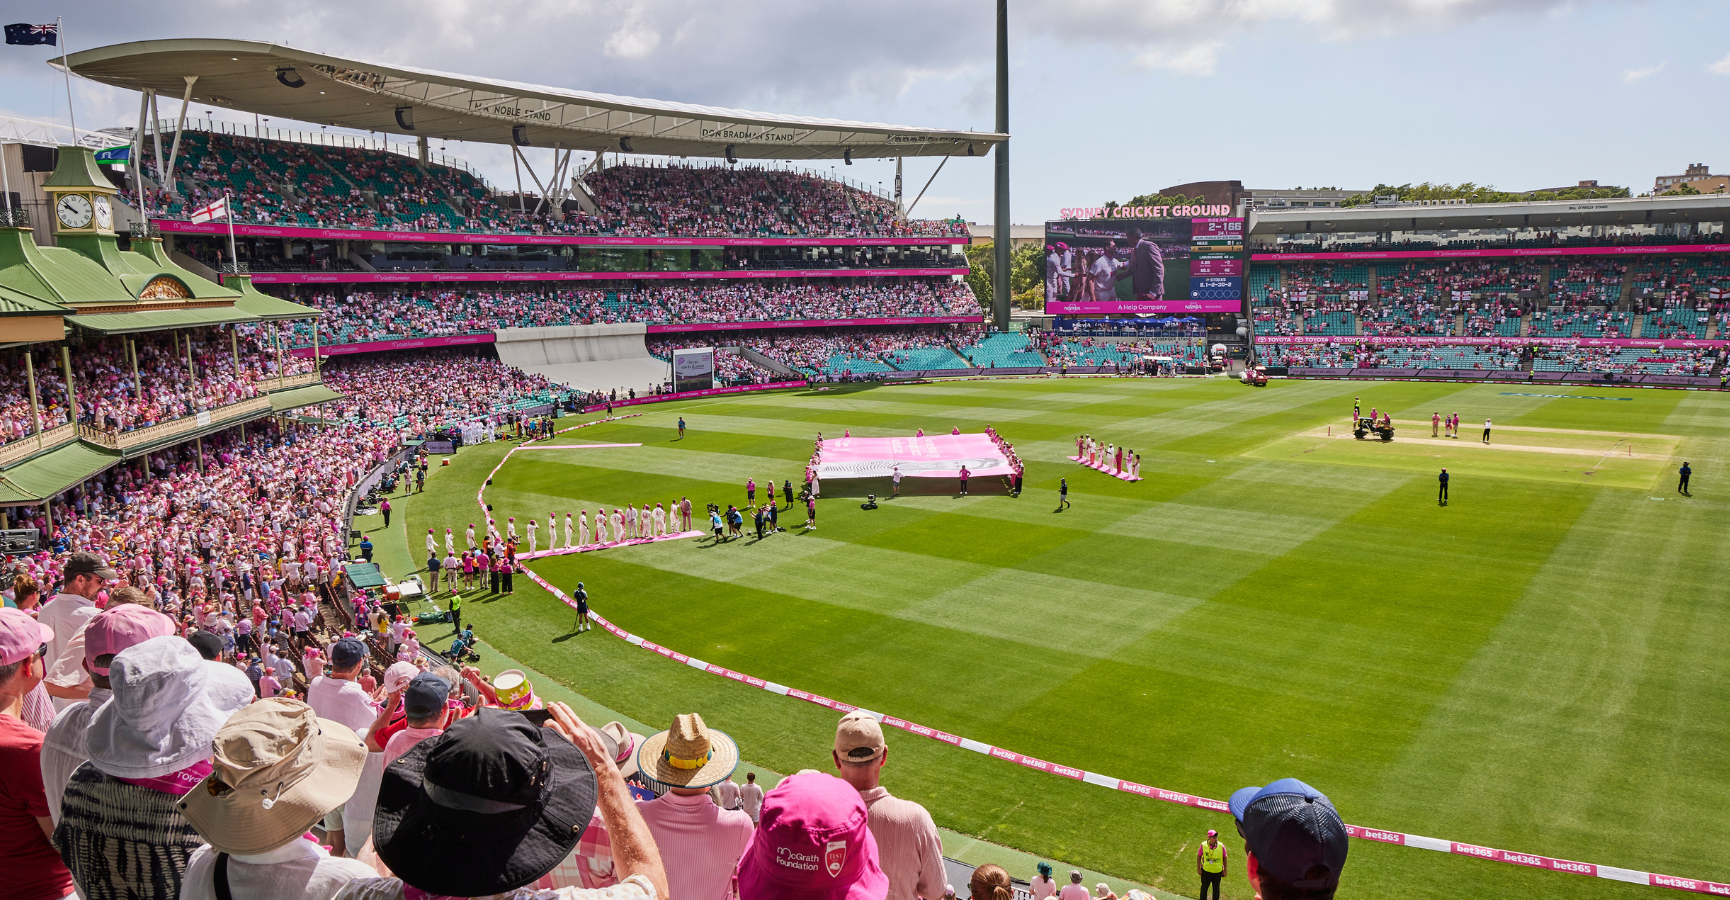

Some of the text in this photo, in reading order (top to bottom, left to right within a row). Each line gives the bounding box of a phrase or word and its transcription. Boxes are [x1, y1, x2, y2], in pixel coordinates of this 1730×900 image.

[494, 106, 520, 116] NOBLE
[524, 110, 550, 121] STAND
[702, 129, 793, 141] DON BRADMAN STAND
[1060, 204, 1230, 218] SYDNEY CRICKET GROUND
[1208, 222, 1242, 231] 2-166
[708, 666, 764, 686] bet365 bet365 bet365
[790, 690, 855, 712] bet365 bet365 bet365
[885, 717, 958, 743] bet365 bet365 bet365
[992, 748, 1080, 778] bet365 bet365 bet365
[1122, 782, 1228, 811] bet365 bet365 bet365
[1365, 830, 1399, 842] bet365
[777, 846, 819, 862] McGrath
[1457, 844, 1591, 873] bet365 bet365 bet365
[776, 856, 818, 871] Foundation
[1655, 876, 1730, 894] bet365 bet
